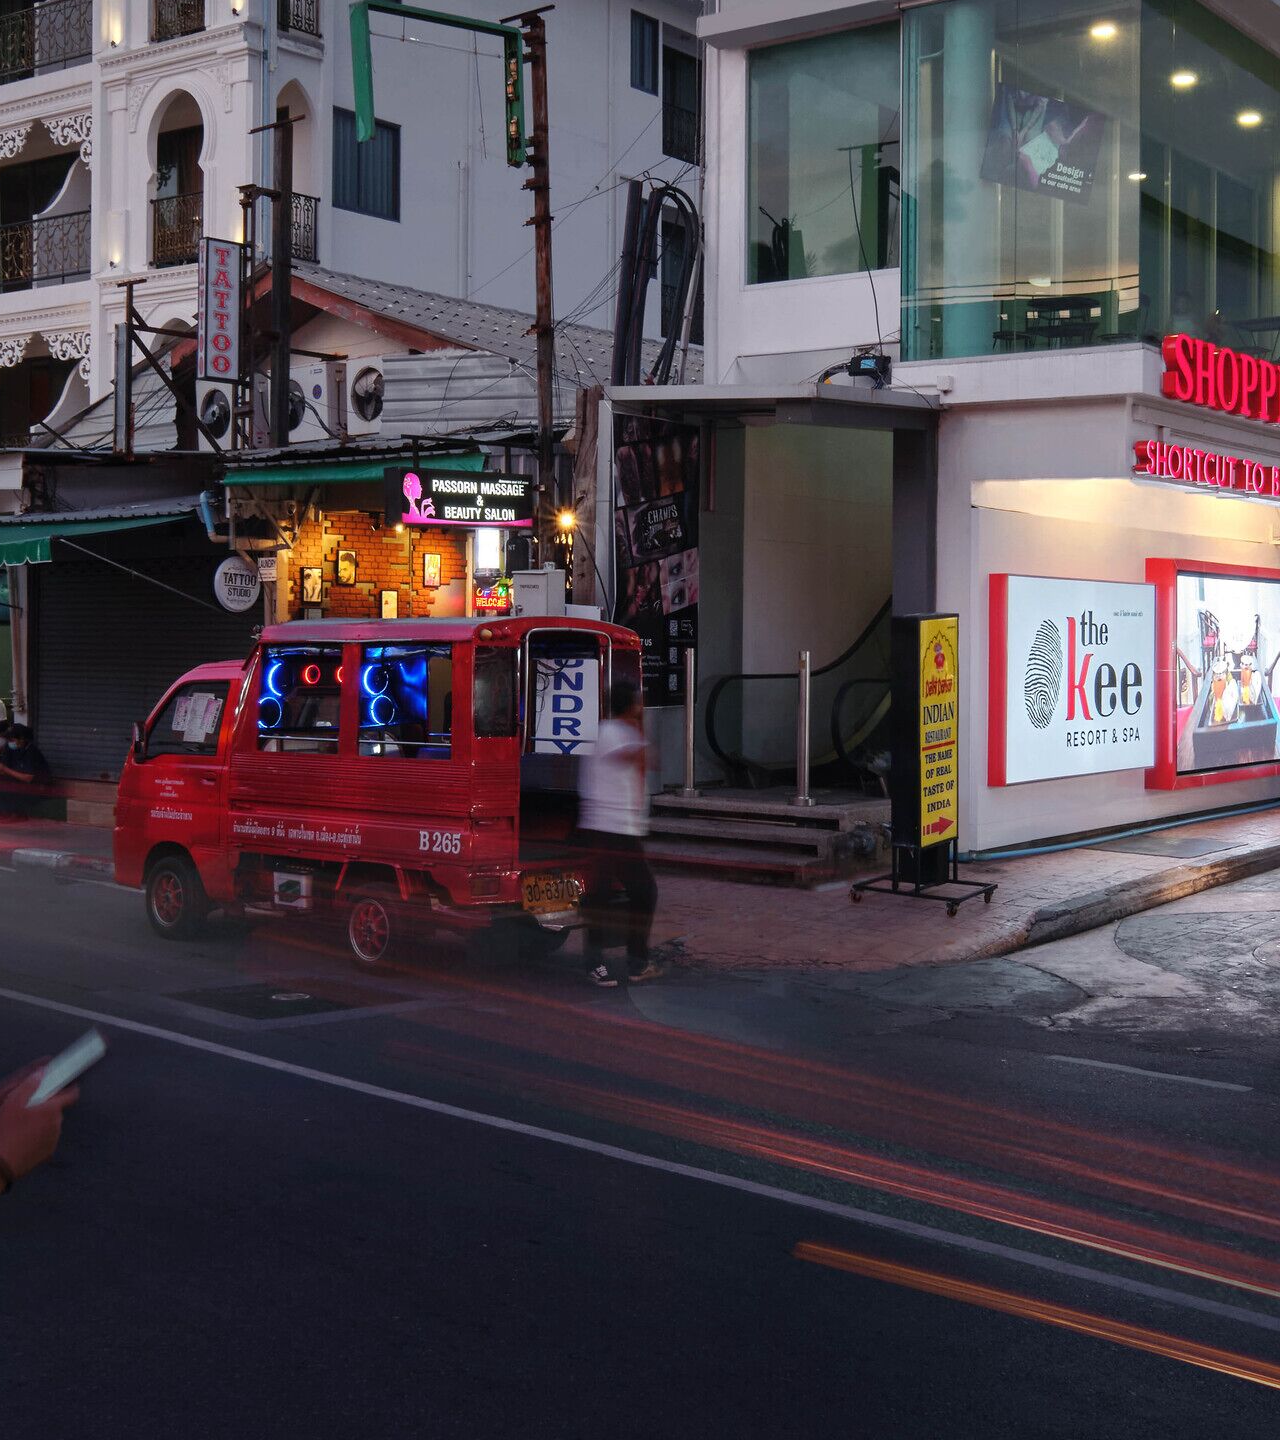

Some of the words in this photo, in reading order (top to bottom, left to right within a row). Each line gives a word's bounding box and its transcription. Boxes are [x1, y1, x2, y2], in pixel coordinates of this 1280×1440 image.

[1047, 172, 1082, 186] consultations
[1056, 163, 1084, 179] Design
[1047, 179, 1057, 187] our
[211, 245, 232, 374] TATTOO
[1144, 439, 1238, 489] SHORTCUT
[1242, 458, 1265, 494] TO
[432, 479, 478, 494] PASSORN
[480, 482, 525, 497] MASSAGE
[476, 495, 484, 506] &
[444, 506, 481, 520] BEAUTY
[484, 508, 516, 521] SALON
[223, 572, 257, 587] TATTOO
[227, 587, 252, 598] STUDIO
[1080, 609, 1109, 648] the
[1065, 616, 1143, 721] kee
[923, 701, 955, 726] INDIAN
[1066, 728, 1108, 748] RESORT
[1112, 728, 1119, 745] &
[1121, 727, 1141, 743] SPA
[925, 751, 937, 765] THE
[937, 749, 953, 762] NAME
[925, 767, 934, 779] OF
[935, 764, 952, 777] REAL
[923, 783, 944, 798] TASTE
[945, 780, 955, 792] OF
[927, 798, 951, 814] INDIA
[419, 830, 430, 851] B
[432, 831, 462, 855] 265
